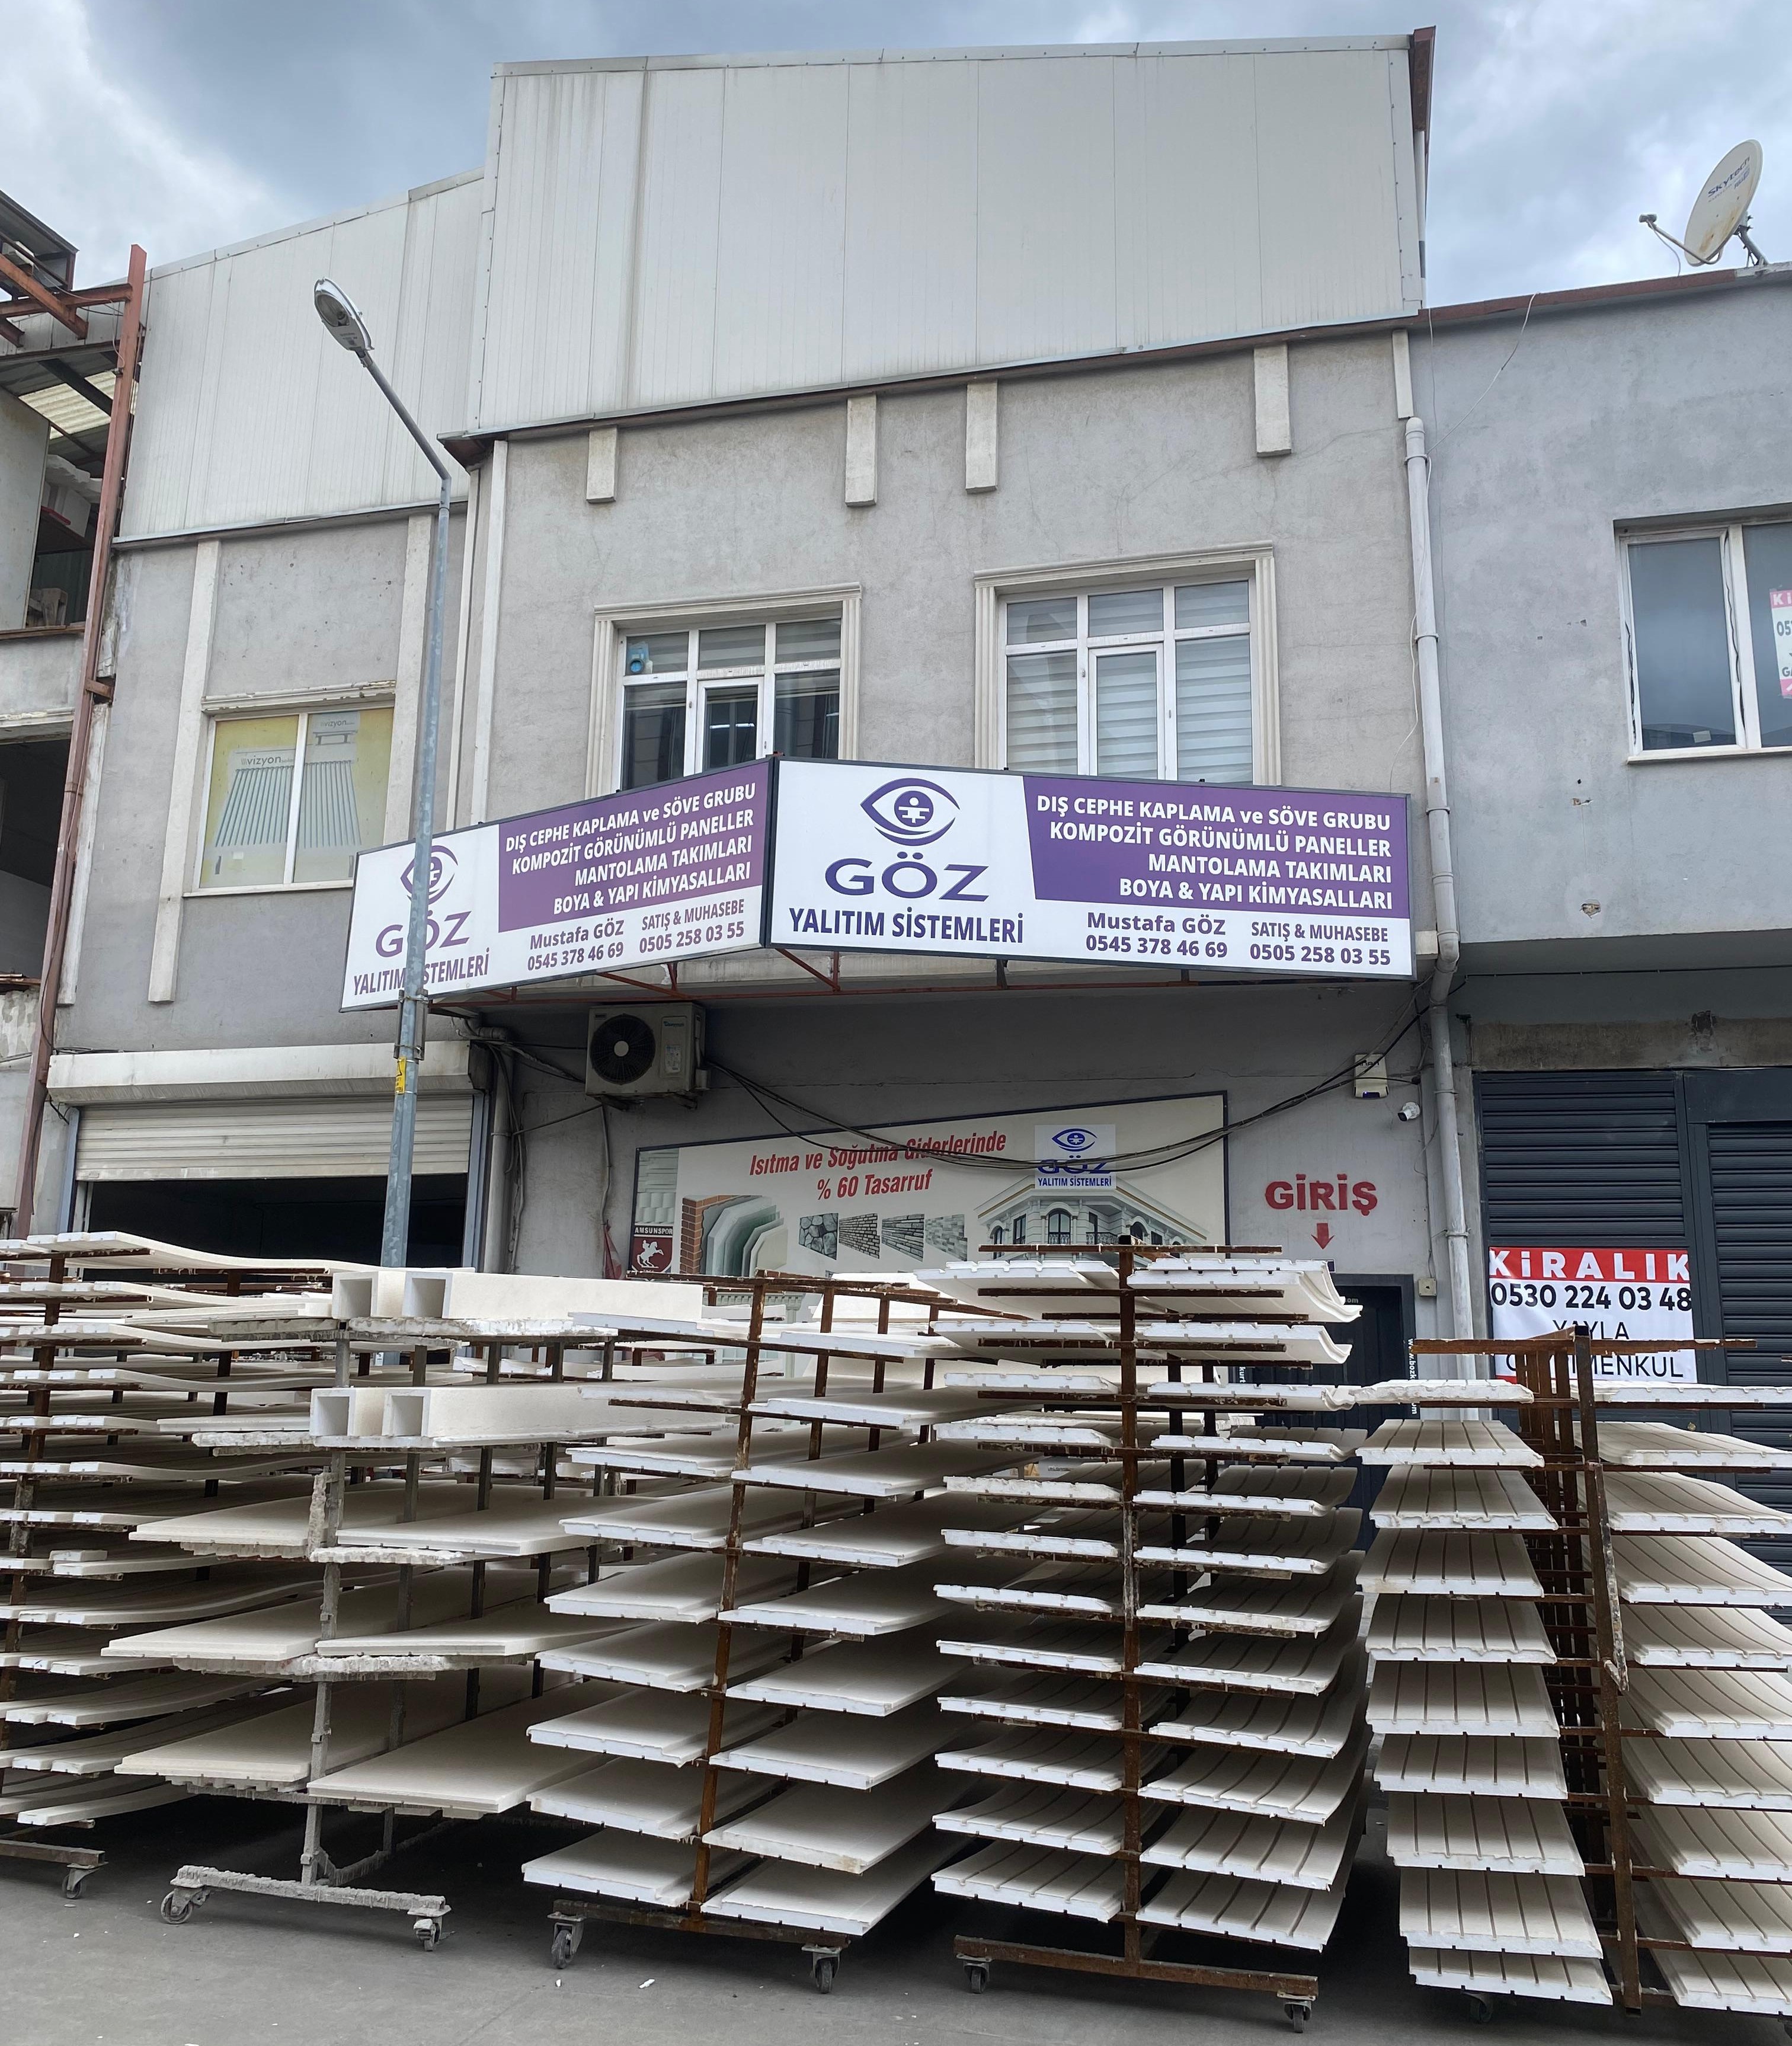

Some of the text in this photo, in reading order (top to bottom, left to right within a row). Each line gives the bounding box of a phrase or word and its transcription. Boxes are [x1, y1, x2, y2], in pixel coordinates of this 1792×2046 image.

[247, 755, 281, 766] vizyon
[505, 783, 756, 853] DIŞ CEPHE KAPLAMA ve SÖVE GRUBU
[1037, 795, 1391, 830] DIŞ CEPHE KAPLAMA ve SÖVE GRUBU
[512, 809, 754, 874] KOMPOZİT GÖRÜNÜMLÜ PANELLER
[1050, 821, 1392, 858] KOMPOZİT GÖRÜNÜMLÜ PANELLER
[575, 835, 752, 886] MANTOLAMA TAKIMLARI
[825, 851, 989, 901] GÖZ
[1148, 854, 1392, 884] MANTOLAMA TAKIMLARI
[553, 862, 751, 915] BOYA & YAPI KİMYASALLARI
[1119, 878, 1393, 910] BOYA & YAPI KİMYASALLARI
[642, 899, 744, 931] SATIŞ & MUHASEBE
[789, 906, 1023, 943] YALITIM SİSTEMLERİ
[1087, 912, 1226, 936] Mustafa GÖZ
[530, 917, 625, 950] Mustafa GÖZ
[639, 921, 744, 954] 0505 258 03 55
[1086, 935, 1228, 958] 0545 378 46 69
[1251, 921, 1388, 943] SATIŞ & MUHASEBE
[527, 942, 623, 971] 0545 378 46 69
[1250, 944, 1391, 966] 0505 258 03 55
[354, 947, 489, 996] YALITIM STEMLERİ
[750, 1131, 1007, 1176] Isıtma ve Soğutma Giderlerinde
[817, 1169, 934, 1200] % 60 Tasarruf
[1038, 1175, 1112, 1187] YALITIM SİSTEMLERİ
[1491, 1283, 1692, 1312] 0530 224 03 48
[1553, 1320, 1630, 1340] YYLA
